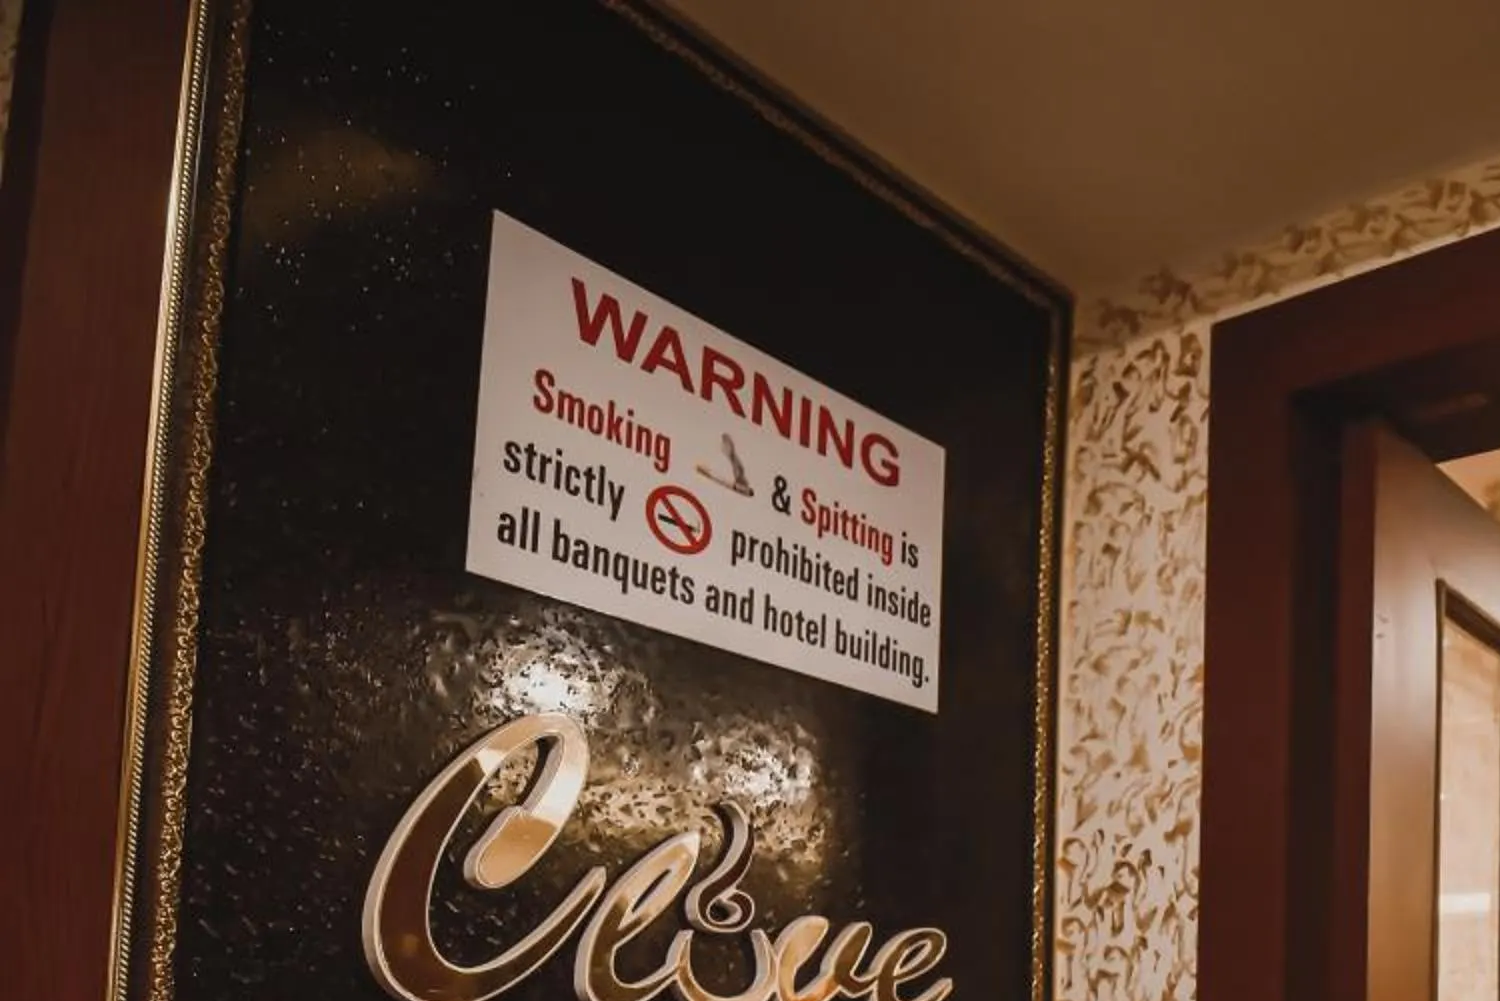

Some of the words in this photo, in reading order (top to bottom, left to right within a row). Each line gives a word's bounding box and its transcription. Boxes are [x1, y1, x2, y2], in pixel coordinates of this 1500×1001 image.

[533, 369, 671, 474] Smoking
[771, 476, 791, 516] &
[801, 488, 893, 566] Spitting
[901, 532, 919, 568] is
[571, 277, 900, 487] WARNING
[498, 507, 539, 554] all
[552, 520, 695, 605] banquets
[705, 582, 754, 625] and
[764, 594, 826, 648] hotel
[835, 623, 929, 688] building.
[503, 440, 625, 521] strictly
[731, 529, 859, 601] prohibited
[867, 574, 931, 628] inside
